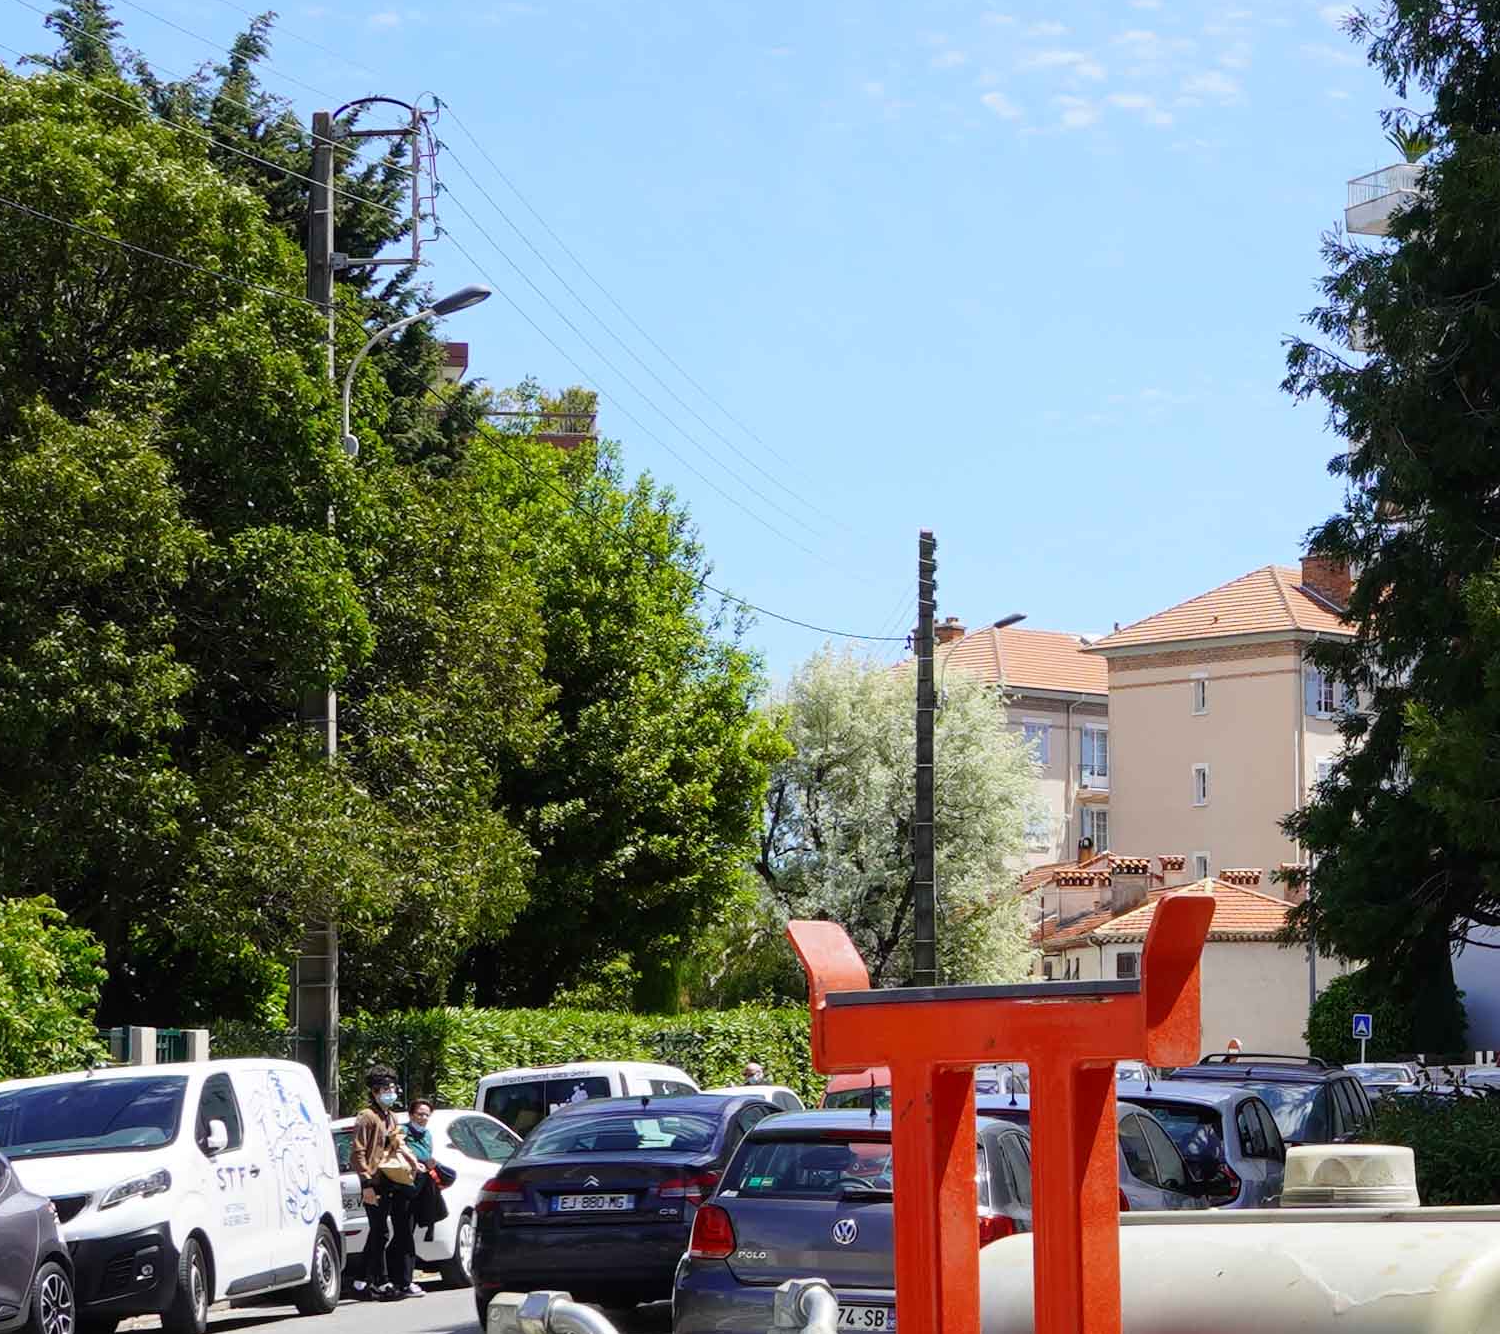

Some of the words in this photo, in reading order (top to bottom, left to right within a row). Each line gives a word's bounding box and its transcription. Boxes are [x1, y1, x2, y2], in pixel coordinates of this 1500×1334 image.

[216, 1166, 246, 1192] STF
[738, 1251, 767, 1259] POLO
[838, 1308, 886, 1327] 74-SB
